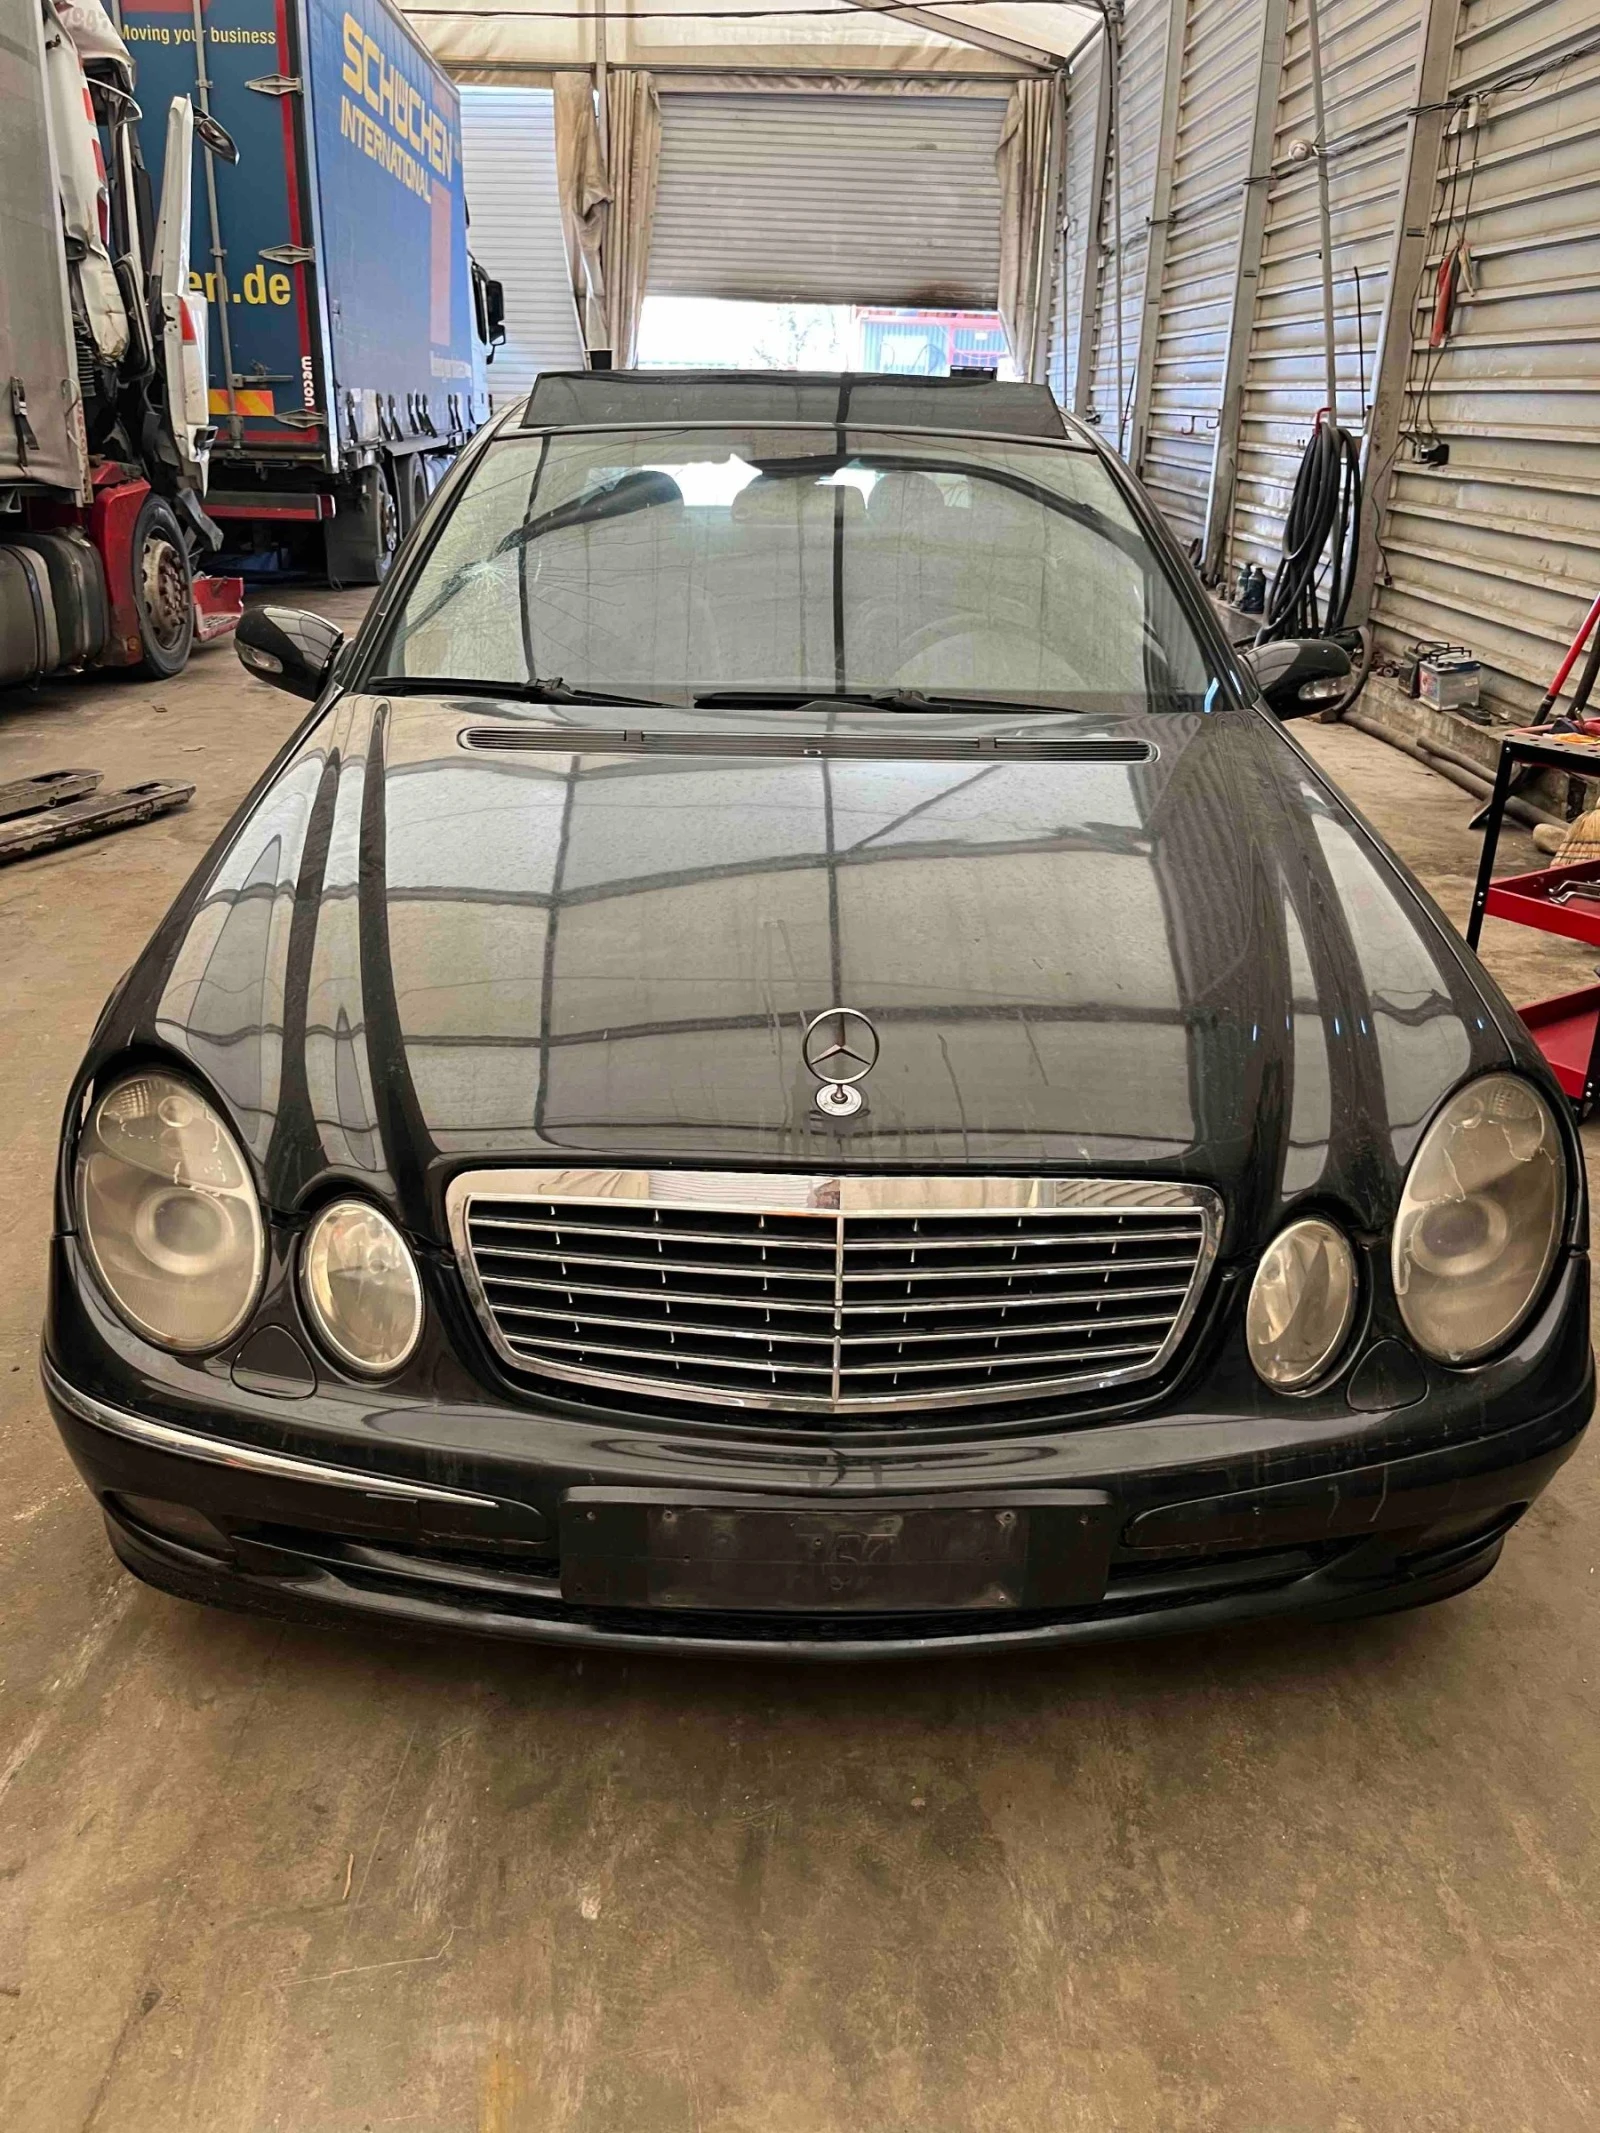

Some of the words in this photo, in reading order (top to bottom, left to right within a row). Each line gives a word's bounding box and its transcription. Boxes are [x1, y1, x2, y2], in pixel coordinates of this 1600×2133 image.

[210, 26, 276, 44] business
[340, 95, 431, 204] INTERNATIONAL
[301, 356, 315, 406] wecon
